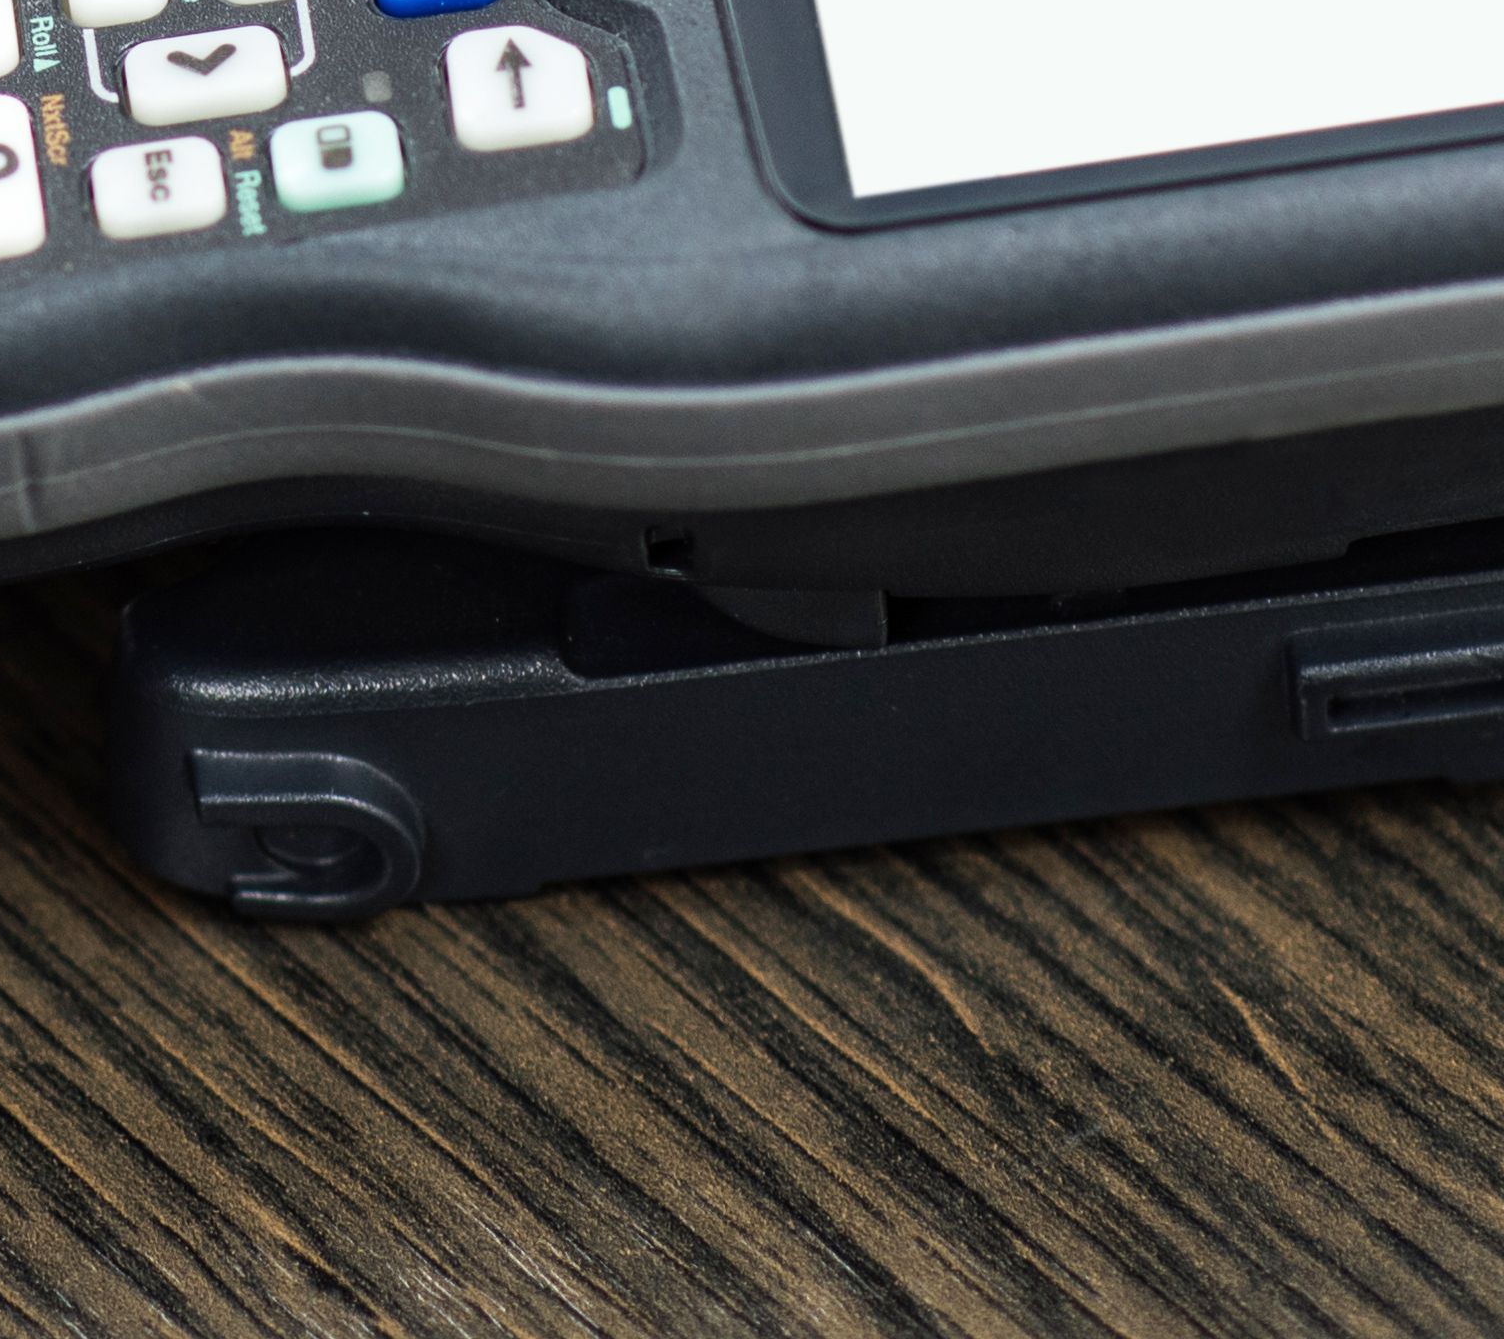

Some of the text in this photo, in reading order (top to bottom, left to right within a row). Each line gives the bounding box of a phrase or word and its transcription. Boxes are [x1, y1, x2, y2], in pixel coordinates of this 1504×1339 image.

[39, 93, 70, 167] NxtScr
[144, 150, 173, 202] Esc
[228, 129, 267, 236] Alt Reset
